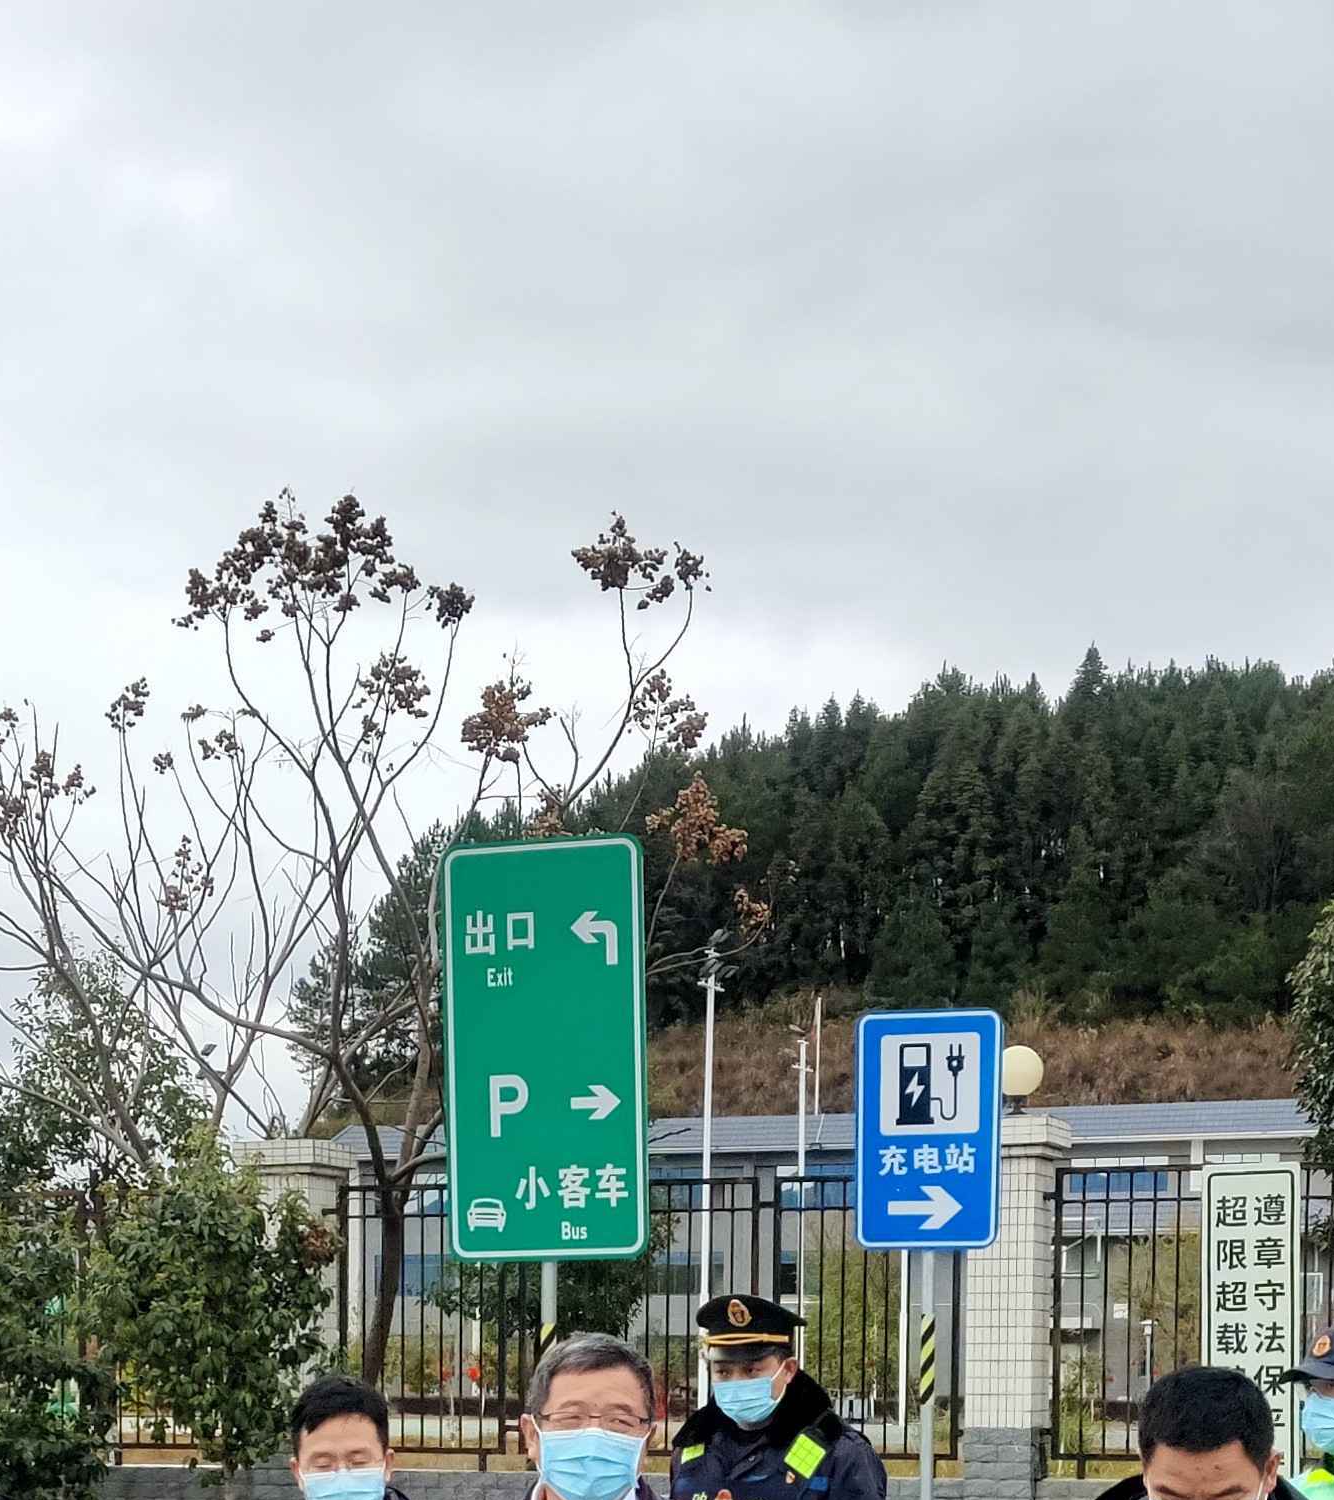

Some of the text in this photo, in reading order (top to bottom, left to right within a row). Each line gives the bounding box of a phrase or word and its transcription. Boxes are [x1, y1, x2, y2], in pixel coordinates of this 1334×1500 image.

[464, 910, 536, 956] 出口
[486, 967, 514, 988] Exit
[489, 1074, 529, 1138] P
[878, 1143, 977, 1176] 充电站
[514, 1163, 630, 1211] 小客车
[560, 1220, 589, 1241] Bus
[1215, 1195, 1248, 1374] 超限超载
[1253, 1194, 1286, 1466] 遵章守法保
